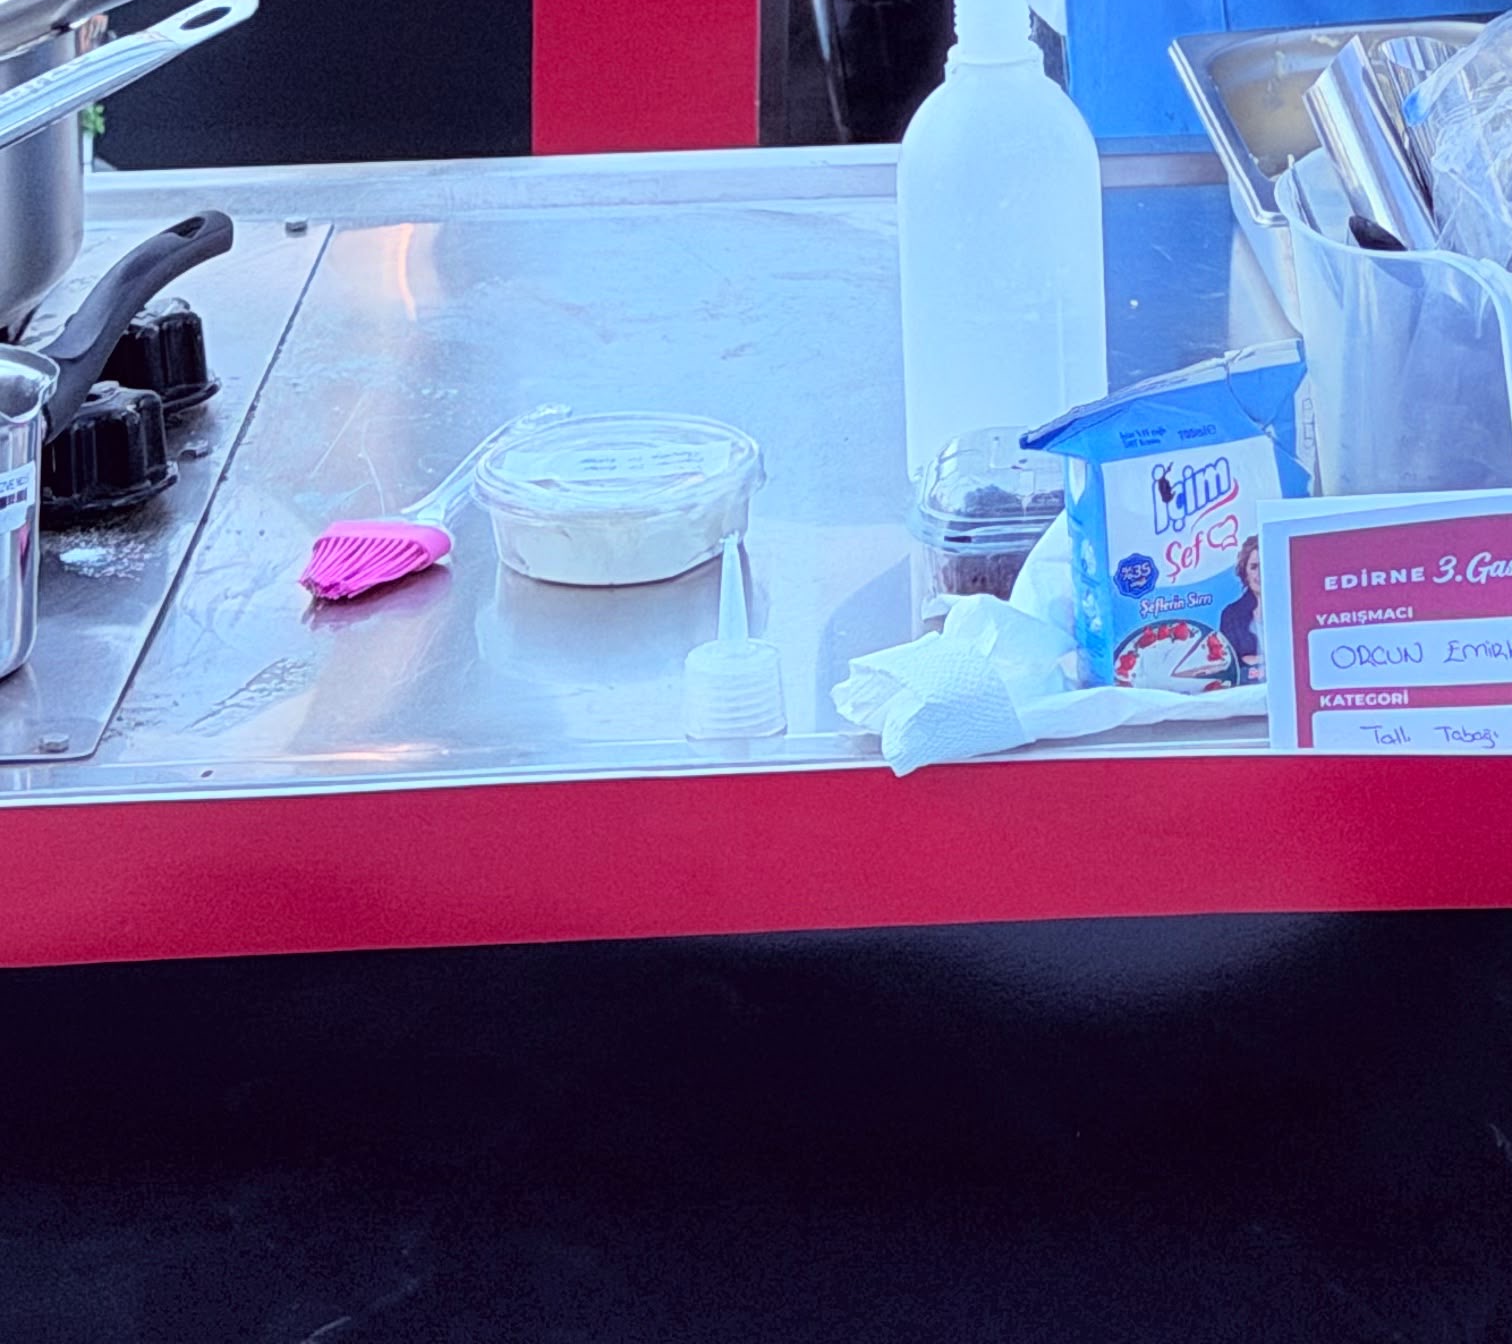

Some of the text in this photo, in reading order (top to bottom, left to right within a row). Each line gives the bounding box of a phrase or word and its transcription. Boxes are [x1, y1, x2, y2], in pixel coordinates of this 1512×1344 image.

[1164, 531, 1205, 584] Şef
[1324, 565, 1426, 591] EDİRNE
[1315, 606, 1414, 627] YARIŞMACI
[1319, 689, 1410, 709] KATEGORİ
